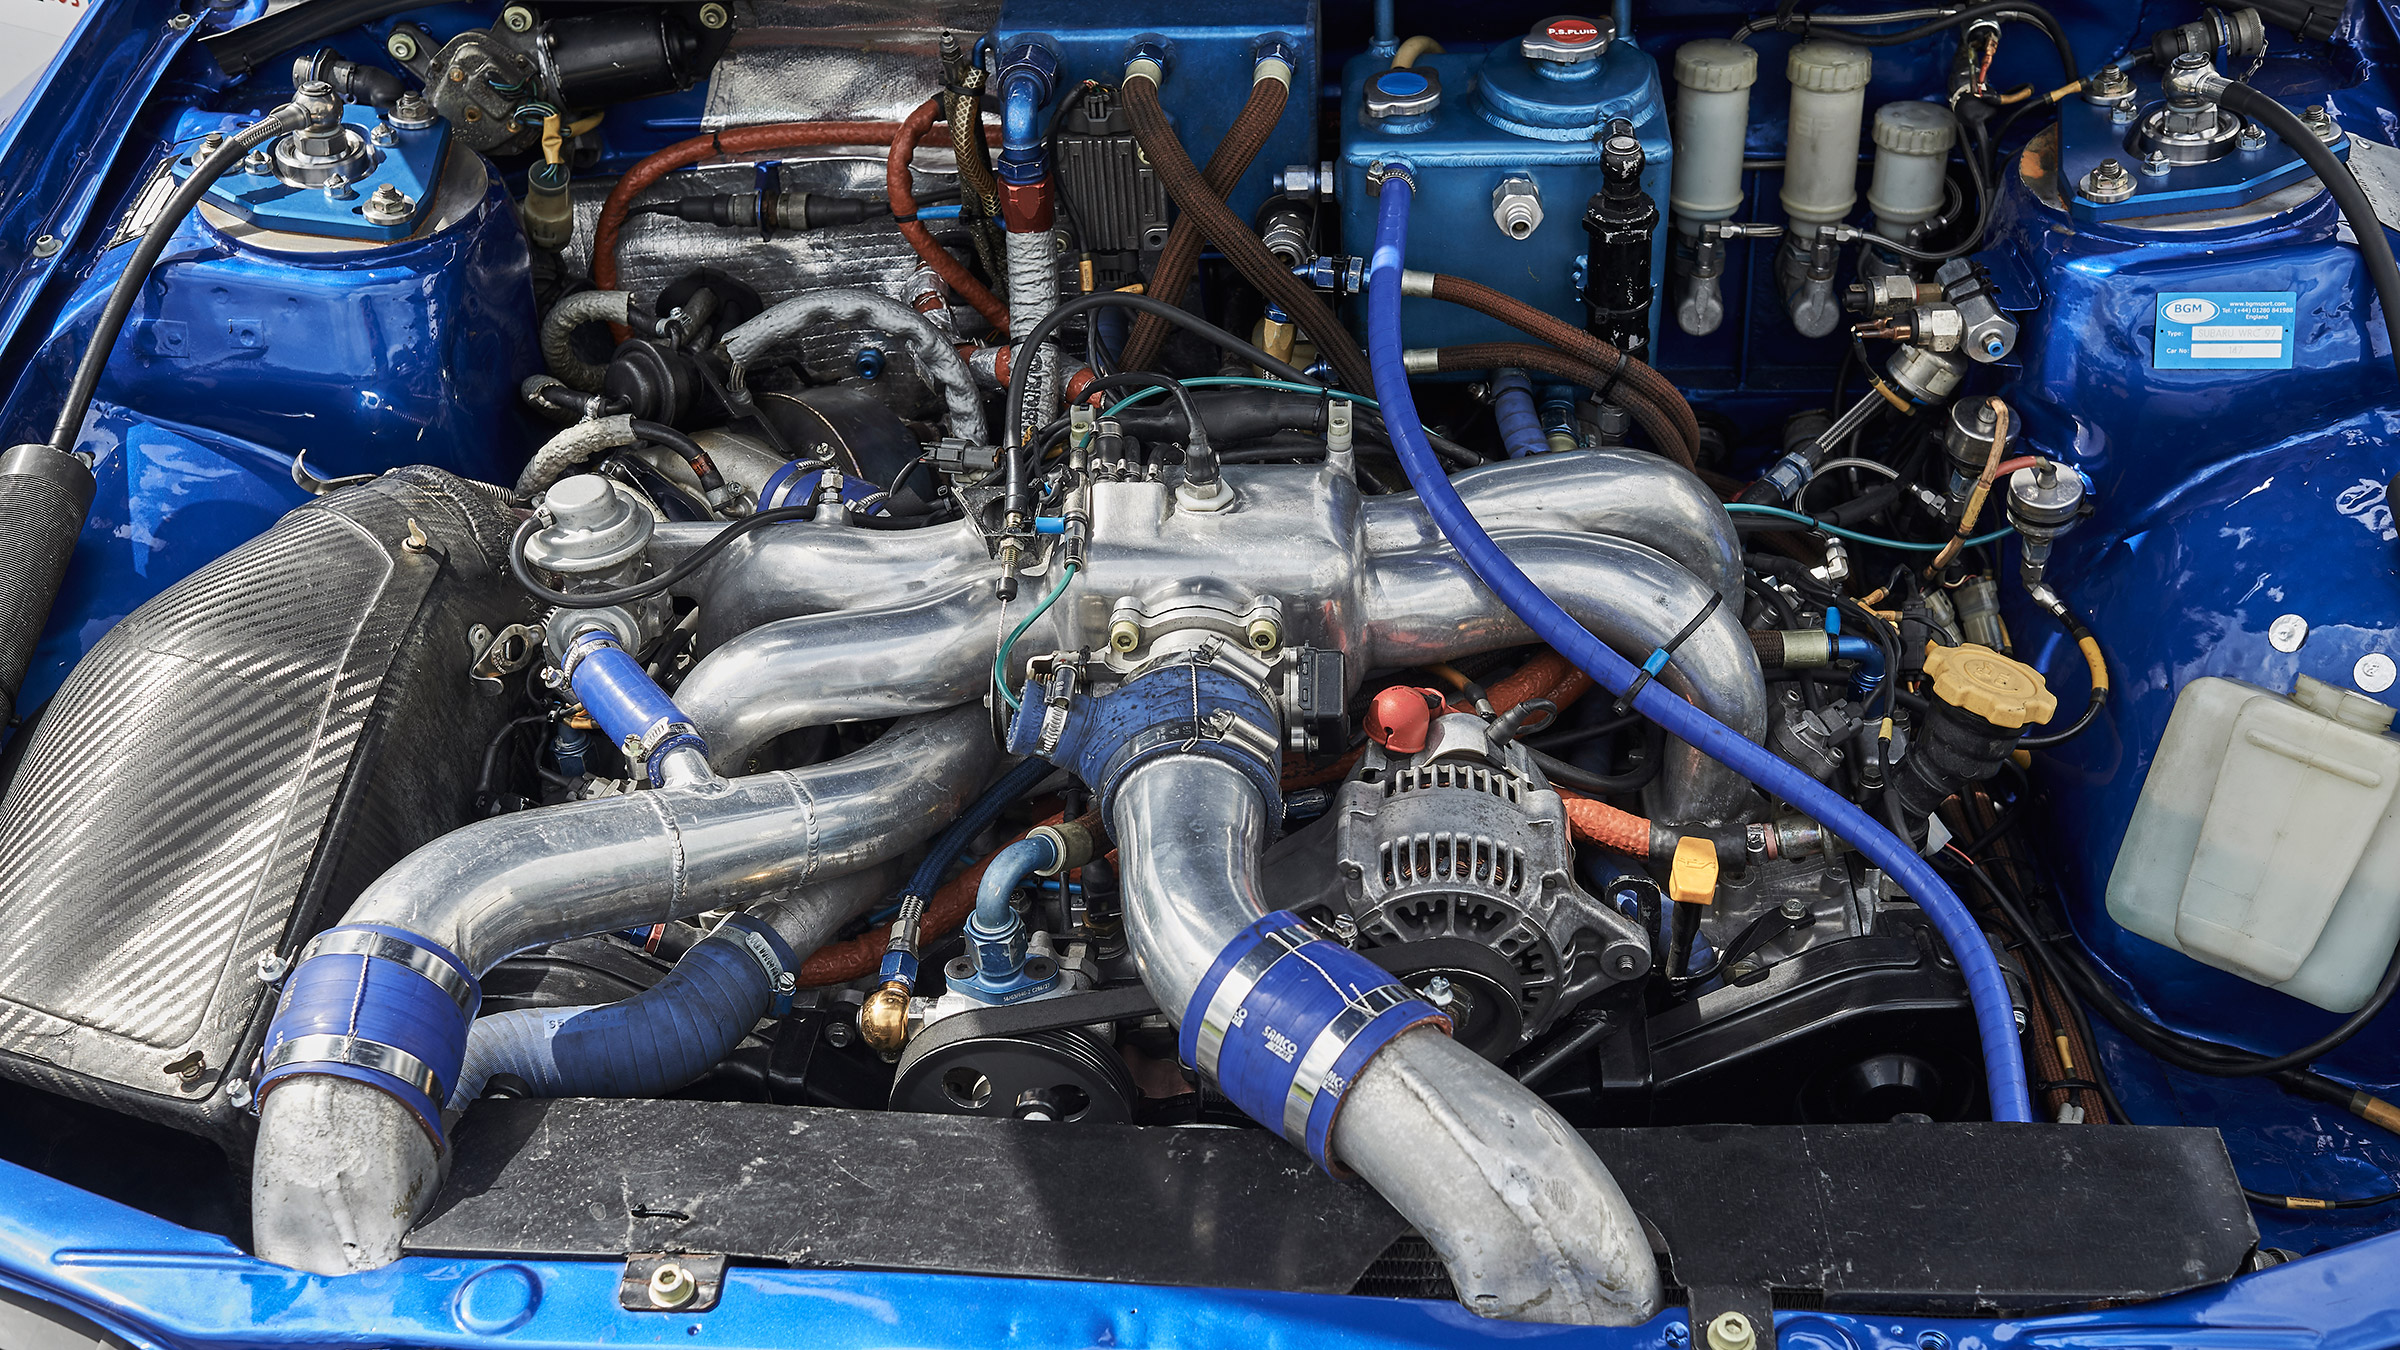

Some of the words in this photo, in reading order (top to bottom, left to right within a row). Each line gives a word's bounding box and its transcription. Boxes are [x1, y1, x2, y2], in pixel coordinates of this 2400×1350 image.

[2174, 303, 2202, 313] BGM
[2198, 329, 2234, 338] SUBARU
[2238, 329, 2260, 337] WRC
[2264, 329, 2276, 337] 97
[2228, 346, 2244, 354] 147
[1261, 1025, 1298, 1055] SAMCO
